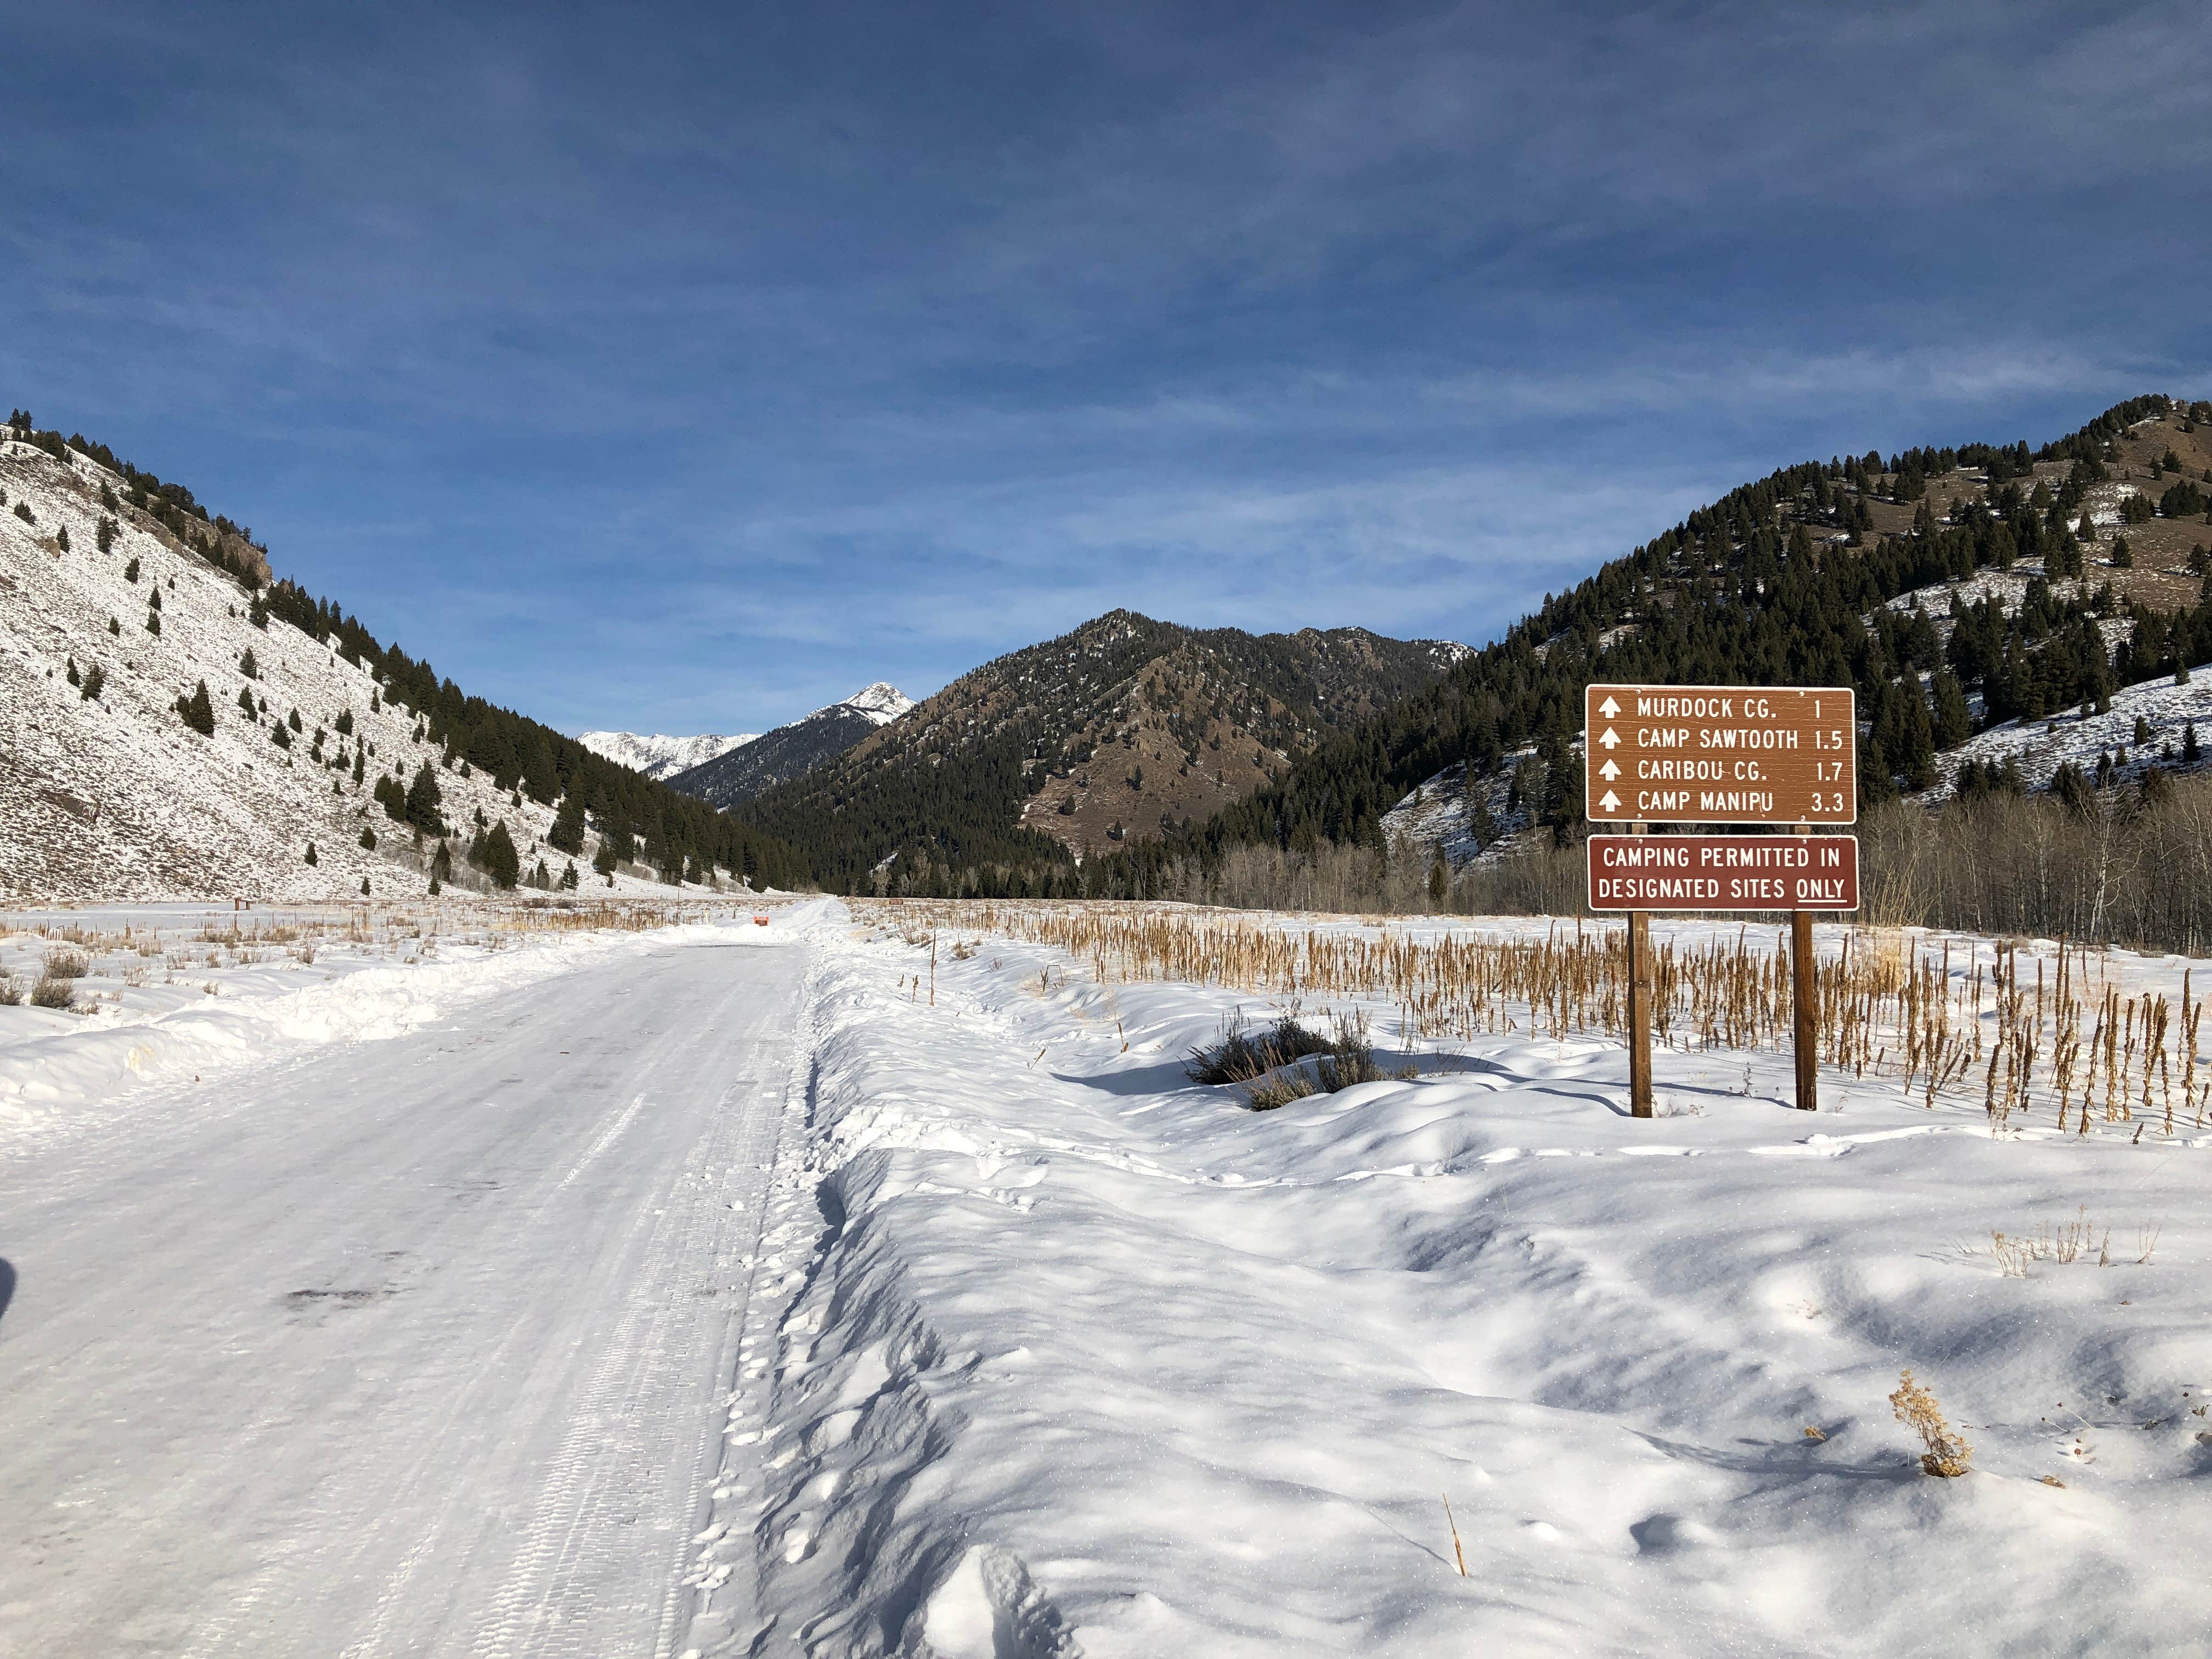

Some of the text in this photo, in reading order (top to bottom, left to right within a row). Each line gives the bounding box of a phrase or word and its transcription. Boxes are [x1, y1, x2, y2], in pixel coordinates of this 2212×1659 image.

[1638, 697, 1820, 719] MURDOCK CG. 1
[1638, 728, 1843, 750] CAMP SAWTOOTH 1.5
[1638, 759, 1843, 781] CARIBOU CG. 1.7
[1638, 791, 1843, 812] CAMP MANIPU 3.3
[1603, 847, 1839, 867] CAMPING PERMITTED IN
[1599, 878, 1844, 899] DESIGNATED SITES ONLY
